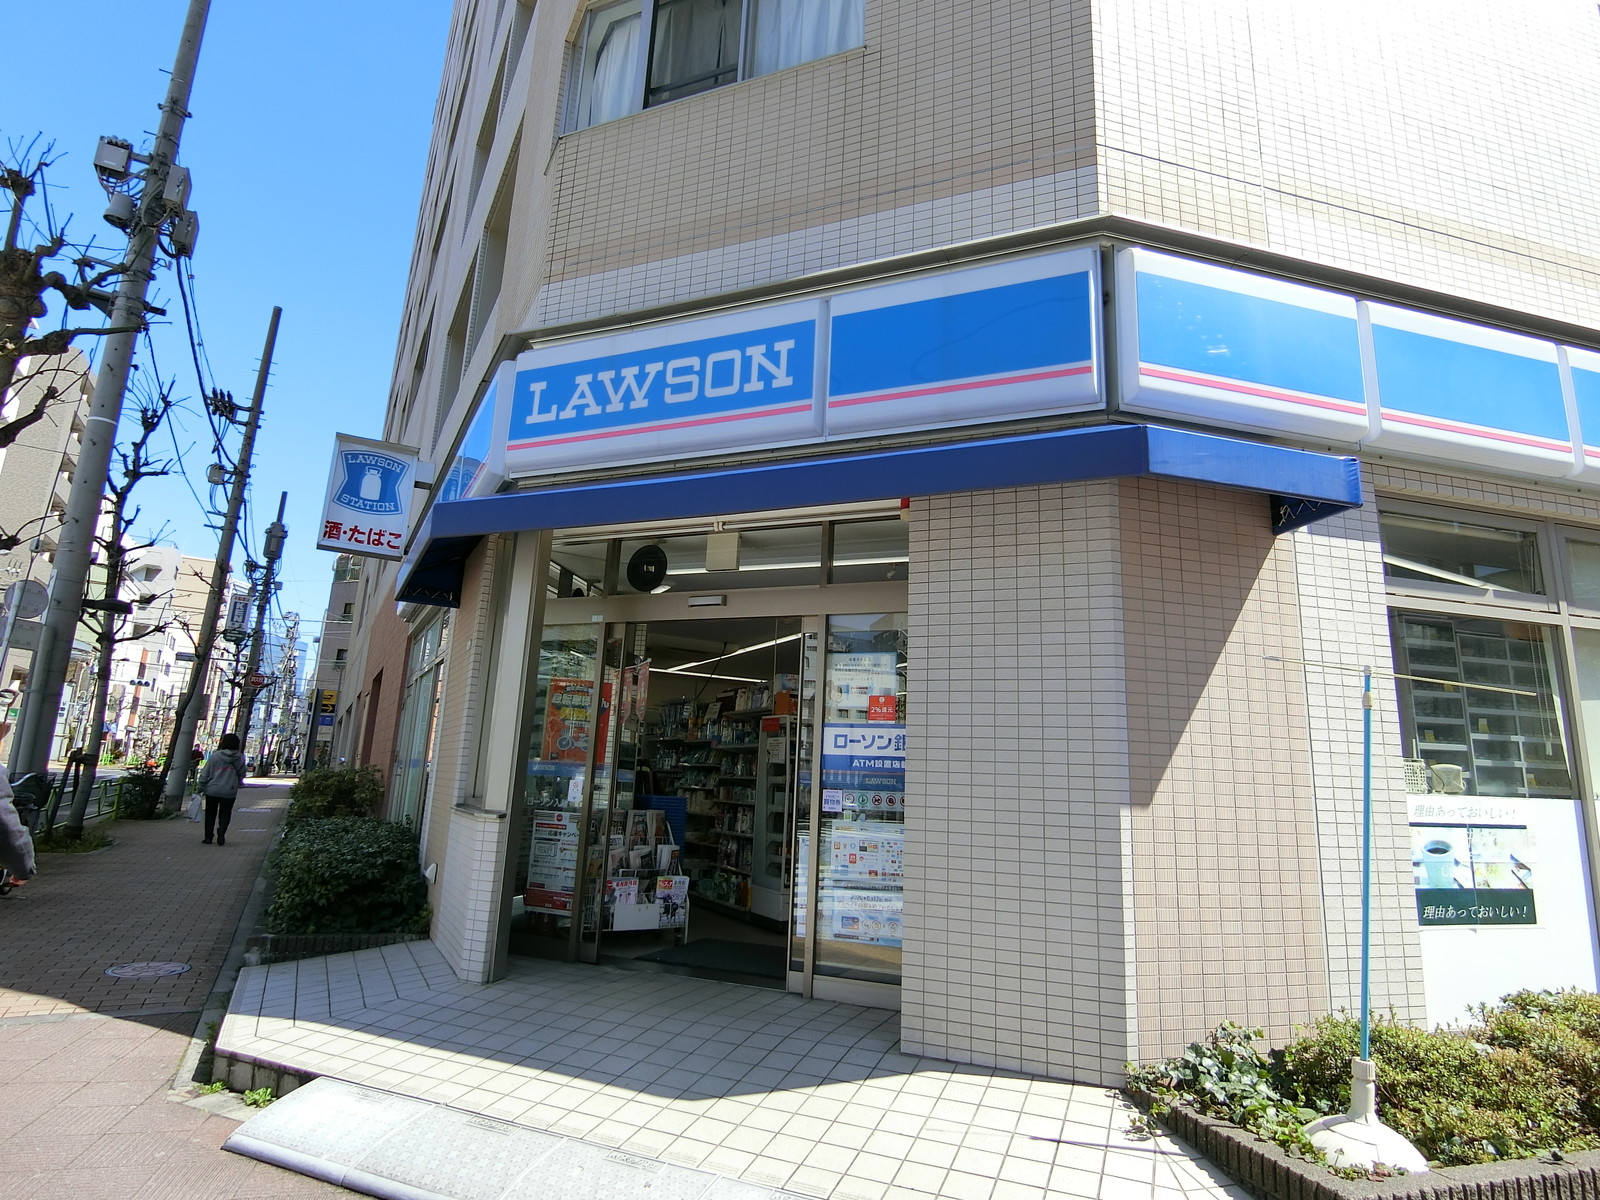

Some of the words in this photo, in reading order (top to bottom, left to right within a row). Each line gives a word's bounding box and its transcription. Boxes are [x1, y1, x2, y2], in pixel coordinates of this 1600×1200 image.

[525, 339, 795, 424] LAWSON
[347, 454, 402, 473] LAWSON
[340, 493, 395, 511] STATION
[323, 520, 402, 550] 酒・たばこ
